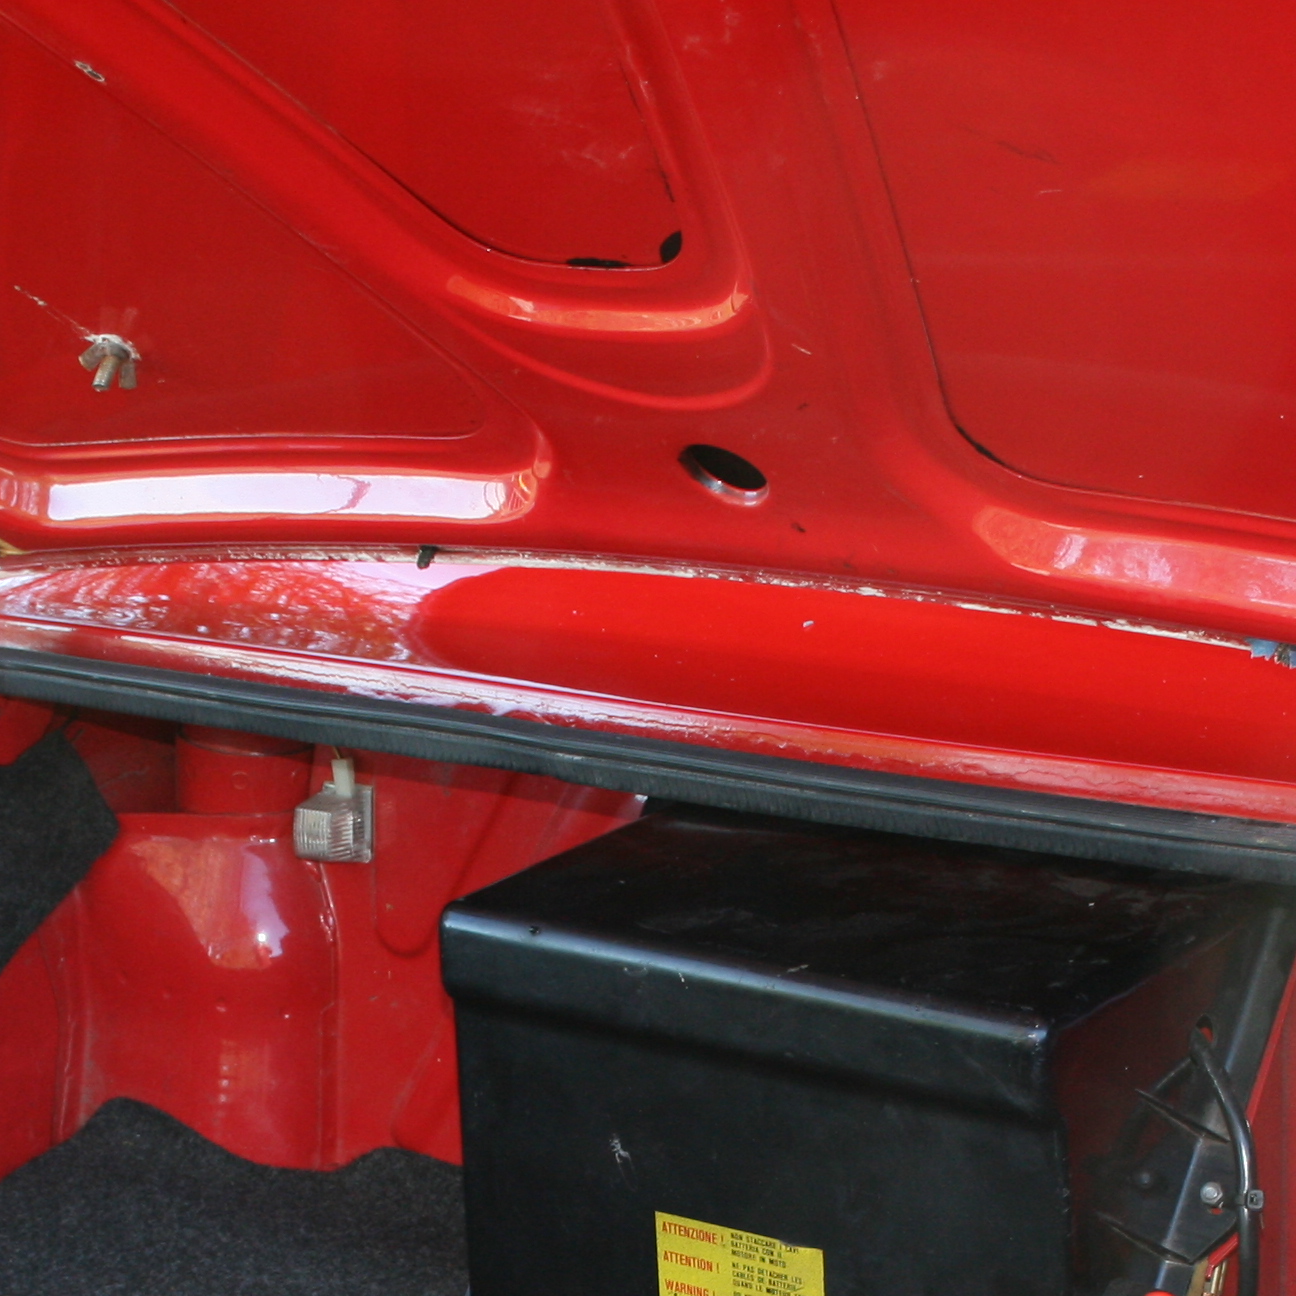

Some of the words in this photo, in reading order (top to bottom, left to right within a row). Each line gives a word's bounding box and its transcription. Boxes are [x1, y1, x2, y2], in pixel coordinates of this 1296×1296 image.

[662, 1221, 718, 1245] ATTENZIONE
[745, 1235, 775, 1249] STACCARE
[730, 1239, 759, 1253] BATTERIA
[761, 1246, 773, 1256] CON
[663, 1250, 713, 1272] ATTENTION
[731, 1248, 756, 1261] MOTORE
[768, 1257, 786, 1268] MOTO
[732, 1269, 754, 1281] CABLES
[742, 1263, 754, 1273] PAS
[756, 1266, 787, 1281] DETACHER
[791, 1274, 802, 1285] LES
[732, 1278, 752, 1290] QUAND
